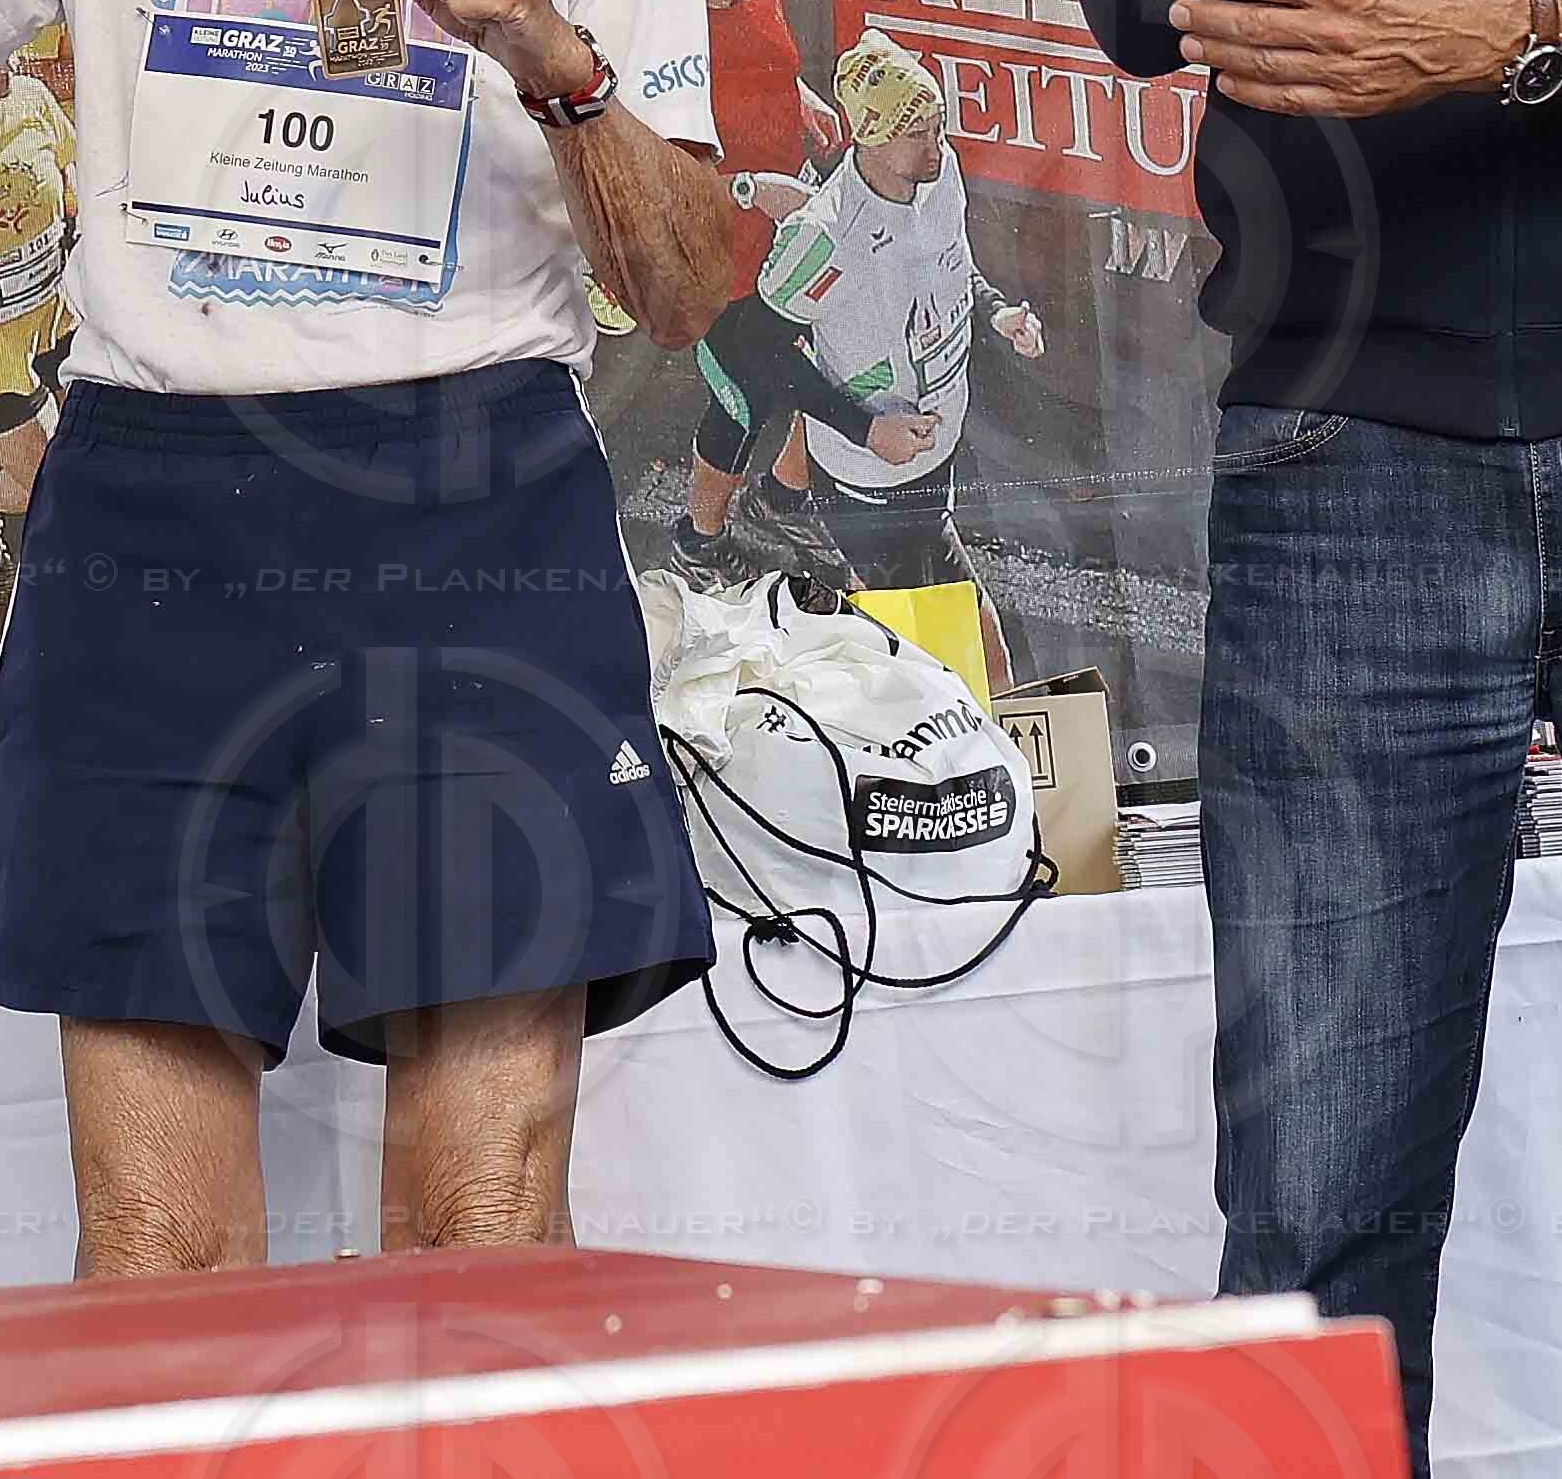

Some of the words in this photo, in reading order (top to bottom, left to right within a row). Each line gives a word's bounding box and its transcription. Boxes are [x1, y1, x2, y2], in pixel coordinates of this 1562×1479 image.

[222, 28, 284, 52] GRAZ
[338, 37, 379, 54] GRAZ
[207, 48, 263, 62] MARATHON
[245, 62, 271, 72] 2023
[366, 72, 436, 95] GRAZ
[642, 54, 705, 99] asics
[918, 49, 1206, 175] EITU
[258, 108, 335, 153] 100
[210, 152, 250, 169] Kleine
[254, 157, 303, 177] Zeitung
[307, 164, 369, 184] Marathon
[241, 180, 305, 210] Julius
[609, 762, 650, 786] adidas
[868, 788, 987, 816] Steiermärkische
[865, 808, 989, 841] SPARKASSE
